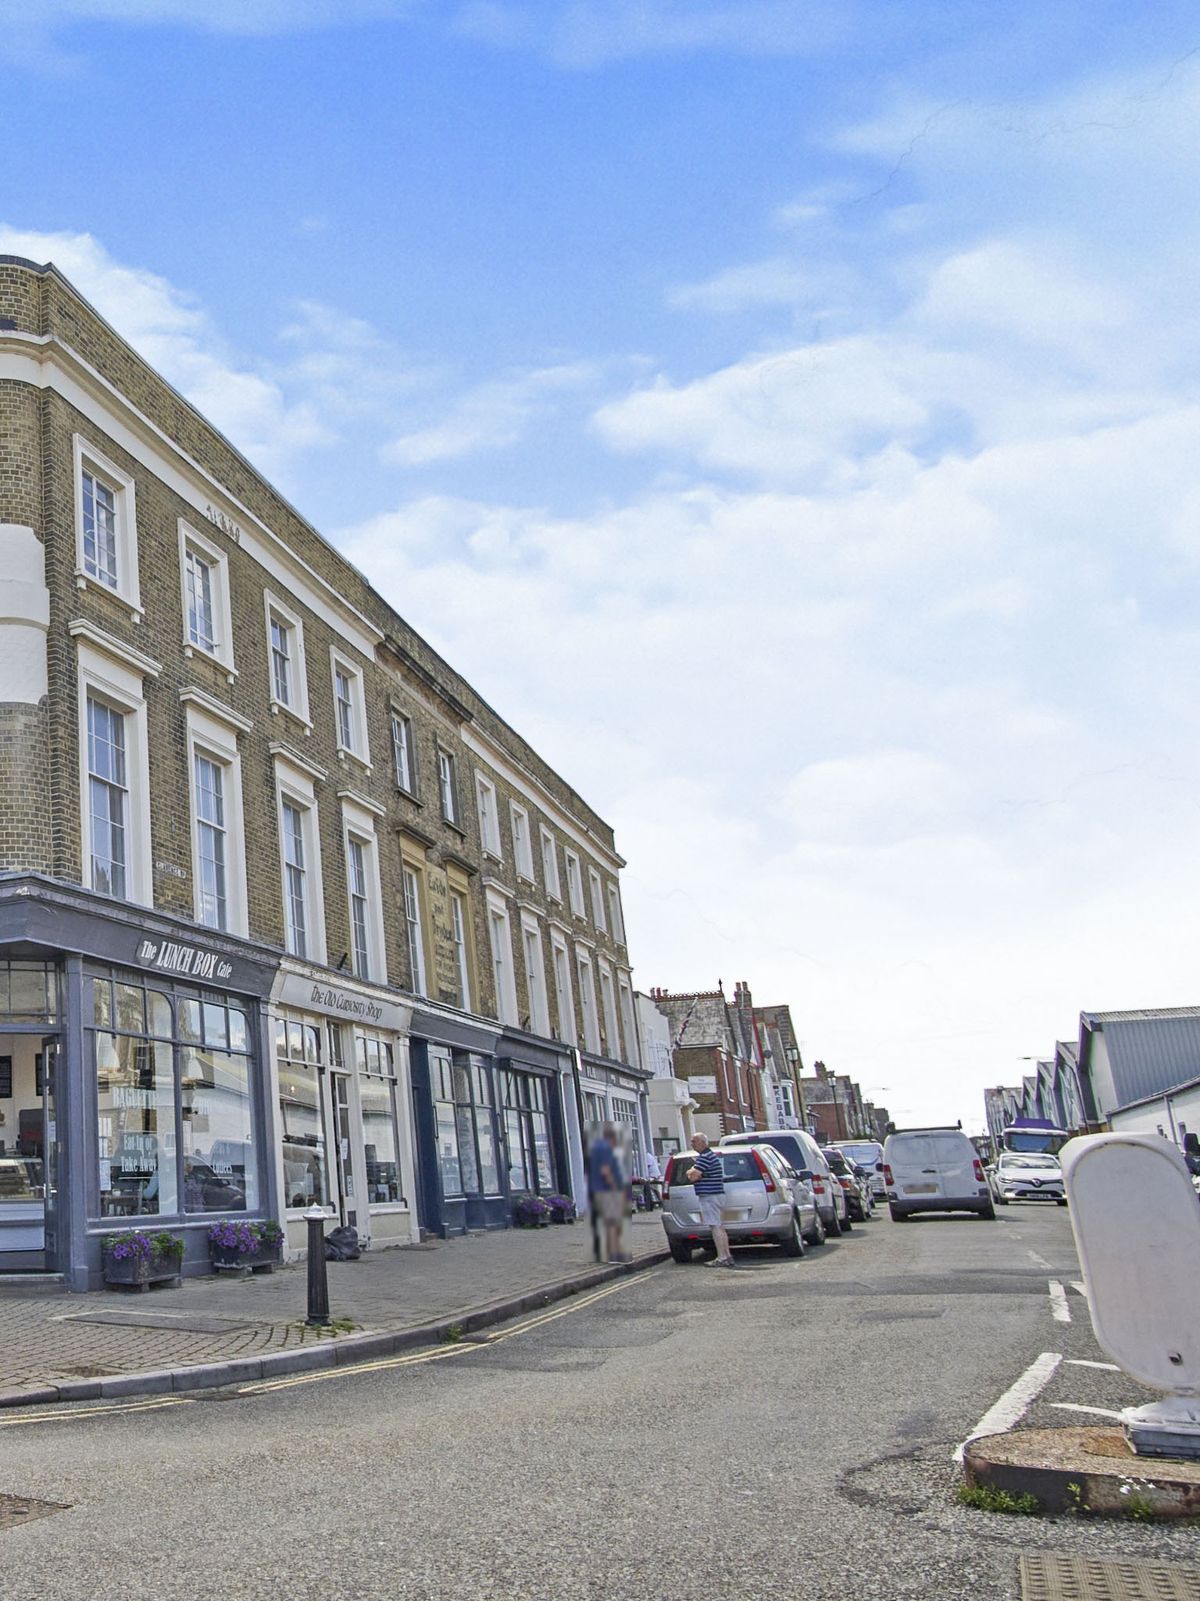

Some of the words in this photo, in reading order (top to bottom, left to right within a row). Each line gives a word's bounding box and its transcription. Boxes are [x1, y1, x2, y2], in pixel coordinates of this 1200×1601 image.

[141, 940, 158, 960] The
[156, 941, 195, 973] LUNCH
[191, 950, 219, 979] BOX
[216, 961, 233, 978] Cafe
[121, 1156, 138, 1173] Take
